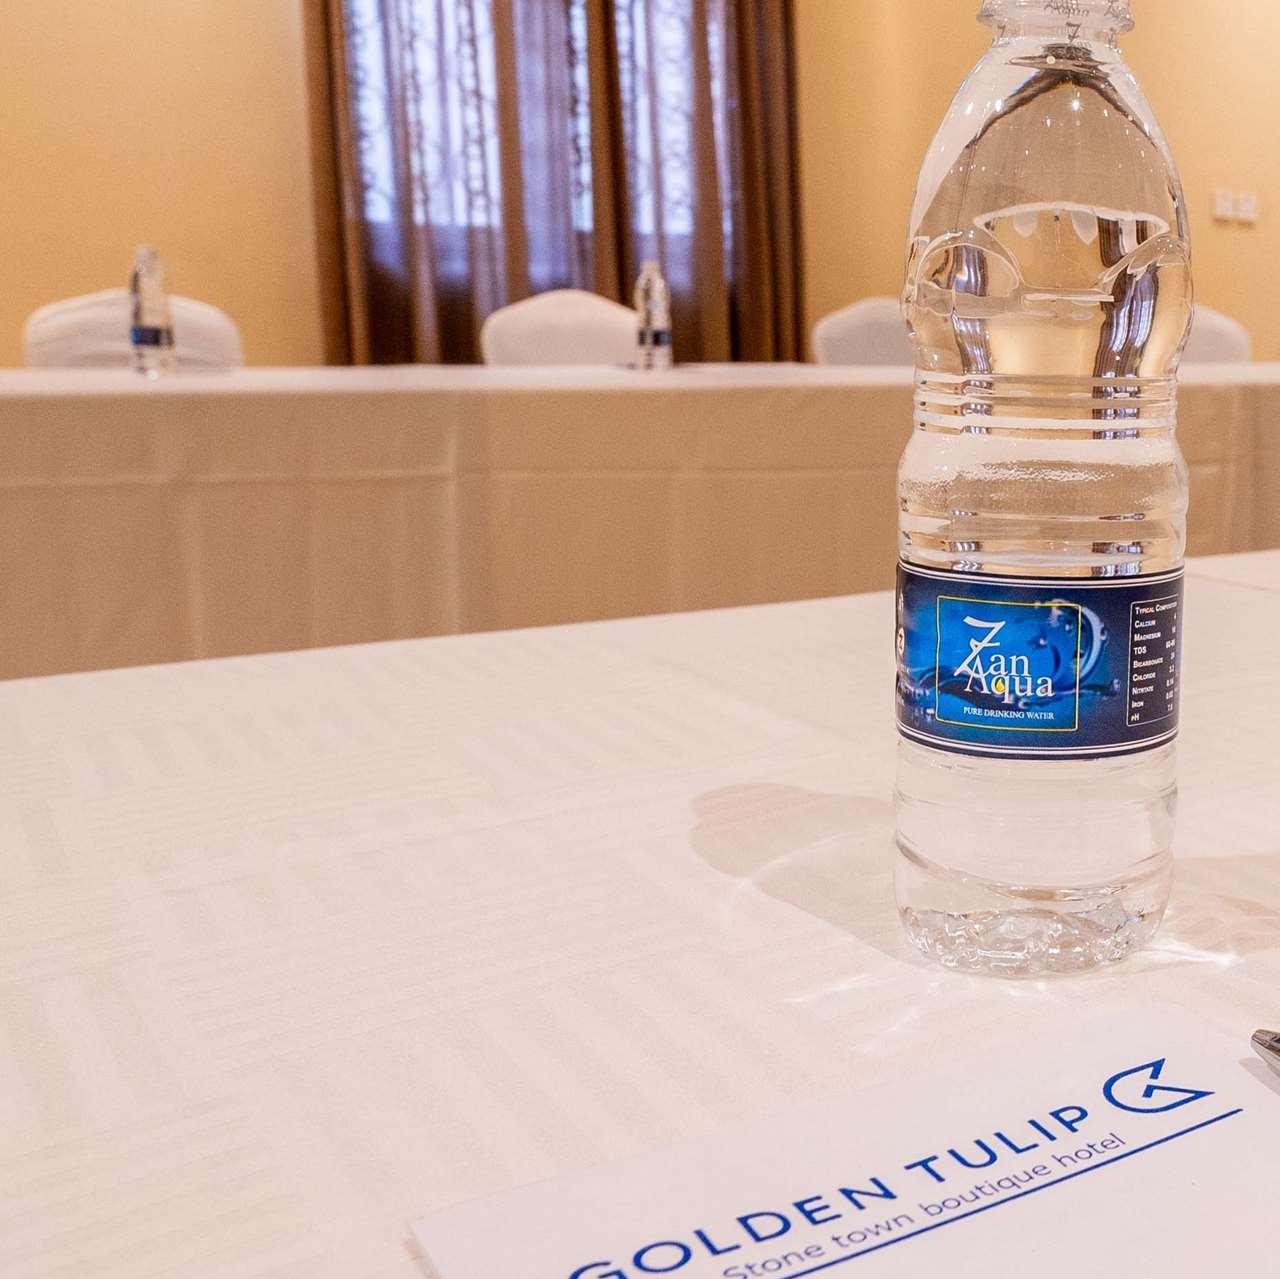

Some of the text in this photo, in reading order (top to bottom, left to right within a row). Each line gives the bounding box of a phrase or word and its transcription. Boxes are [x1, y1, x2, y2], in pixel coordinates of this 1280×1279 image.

[953, 615, 1032, 677] Zan
[963, 654, 1055, 704] Aqua
[963, 706, 1055, 720] PURE DRINKING WATER
[904, 1104, 1090, 1184] TULIP
[830, 1208, 915, 1248] town
[917, 1159, 1052, 1221] boutique
[1053, 1131, 1127, 1169] hotel
